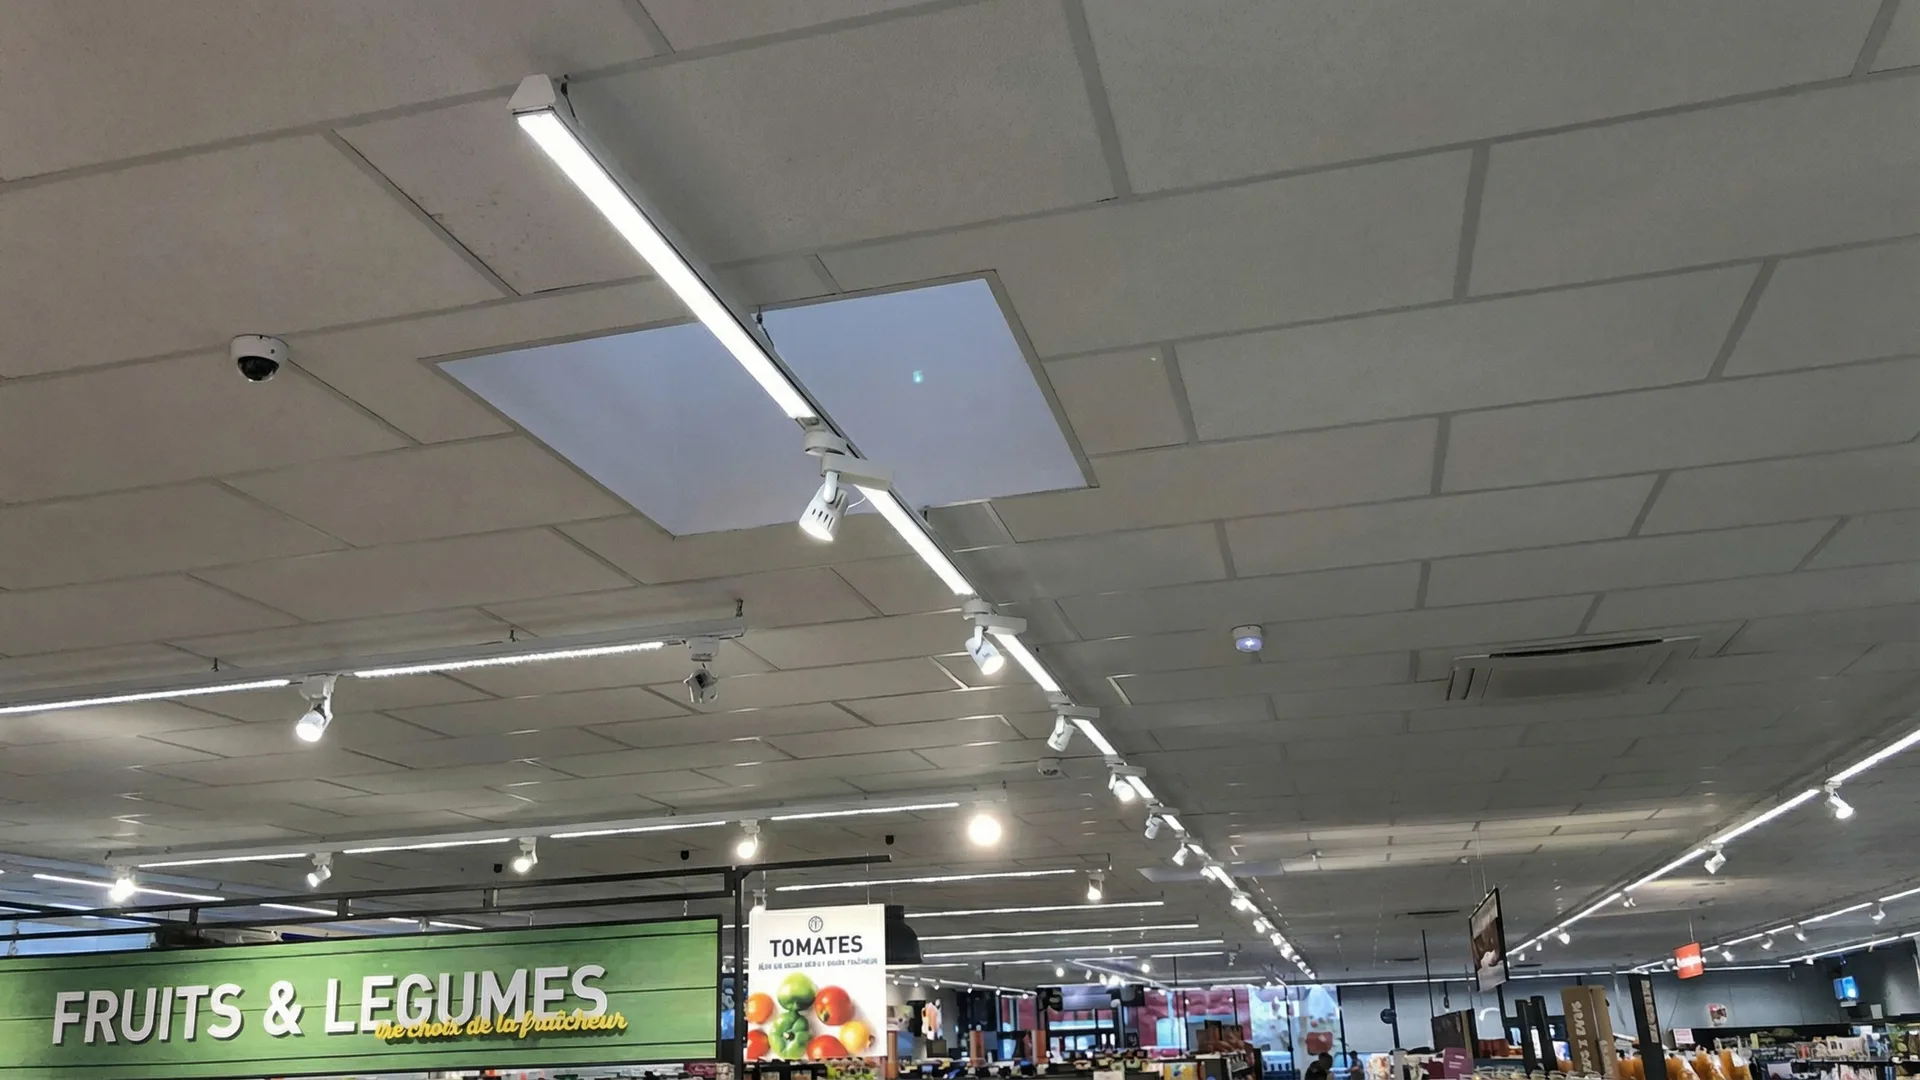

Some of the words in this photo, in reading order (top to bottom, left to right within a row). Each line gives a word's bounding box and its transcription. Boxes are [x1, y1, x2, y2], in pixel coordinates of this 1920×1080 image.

[769, 935, 863, 957] TOMATES
[52, 982, 243, 1045] FRUITS
[262, 978, 305, 1036] &
[322, 965, 608, 1034] LEGUMES
[407, 1016, 463, 1038] choix
[466, 1015, 493, 1035] de
[496, 1013, 519, 1033] la
[519, 1009, 629, 1039] fraîcheur
